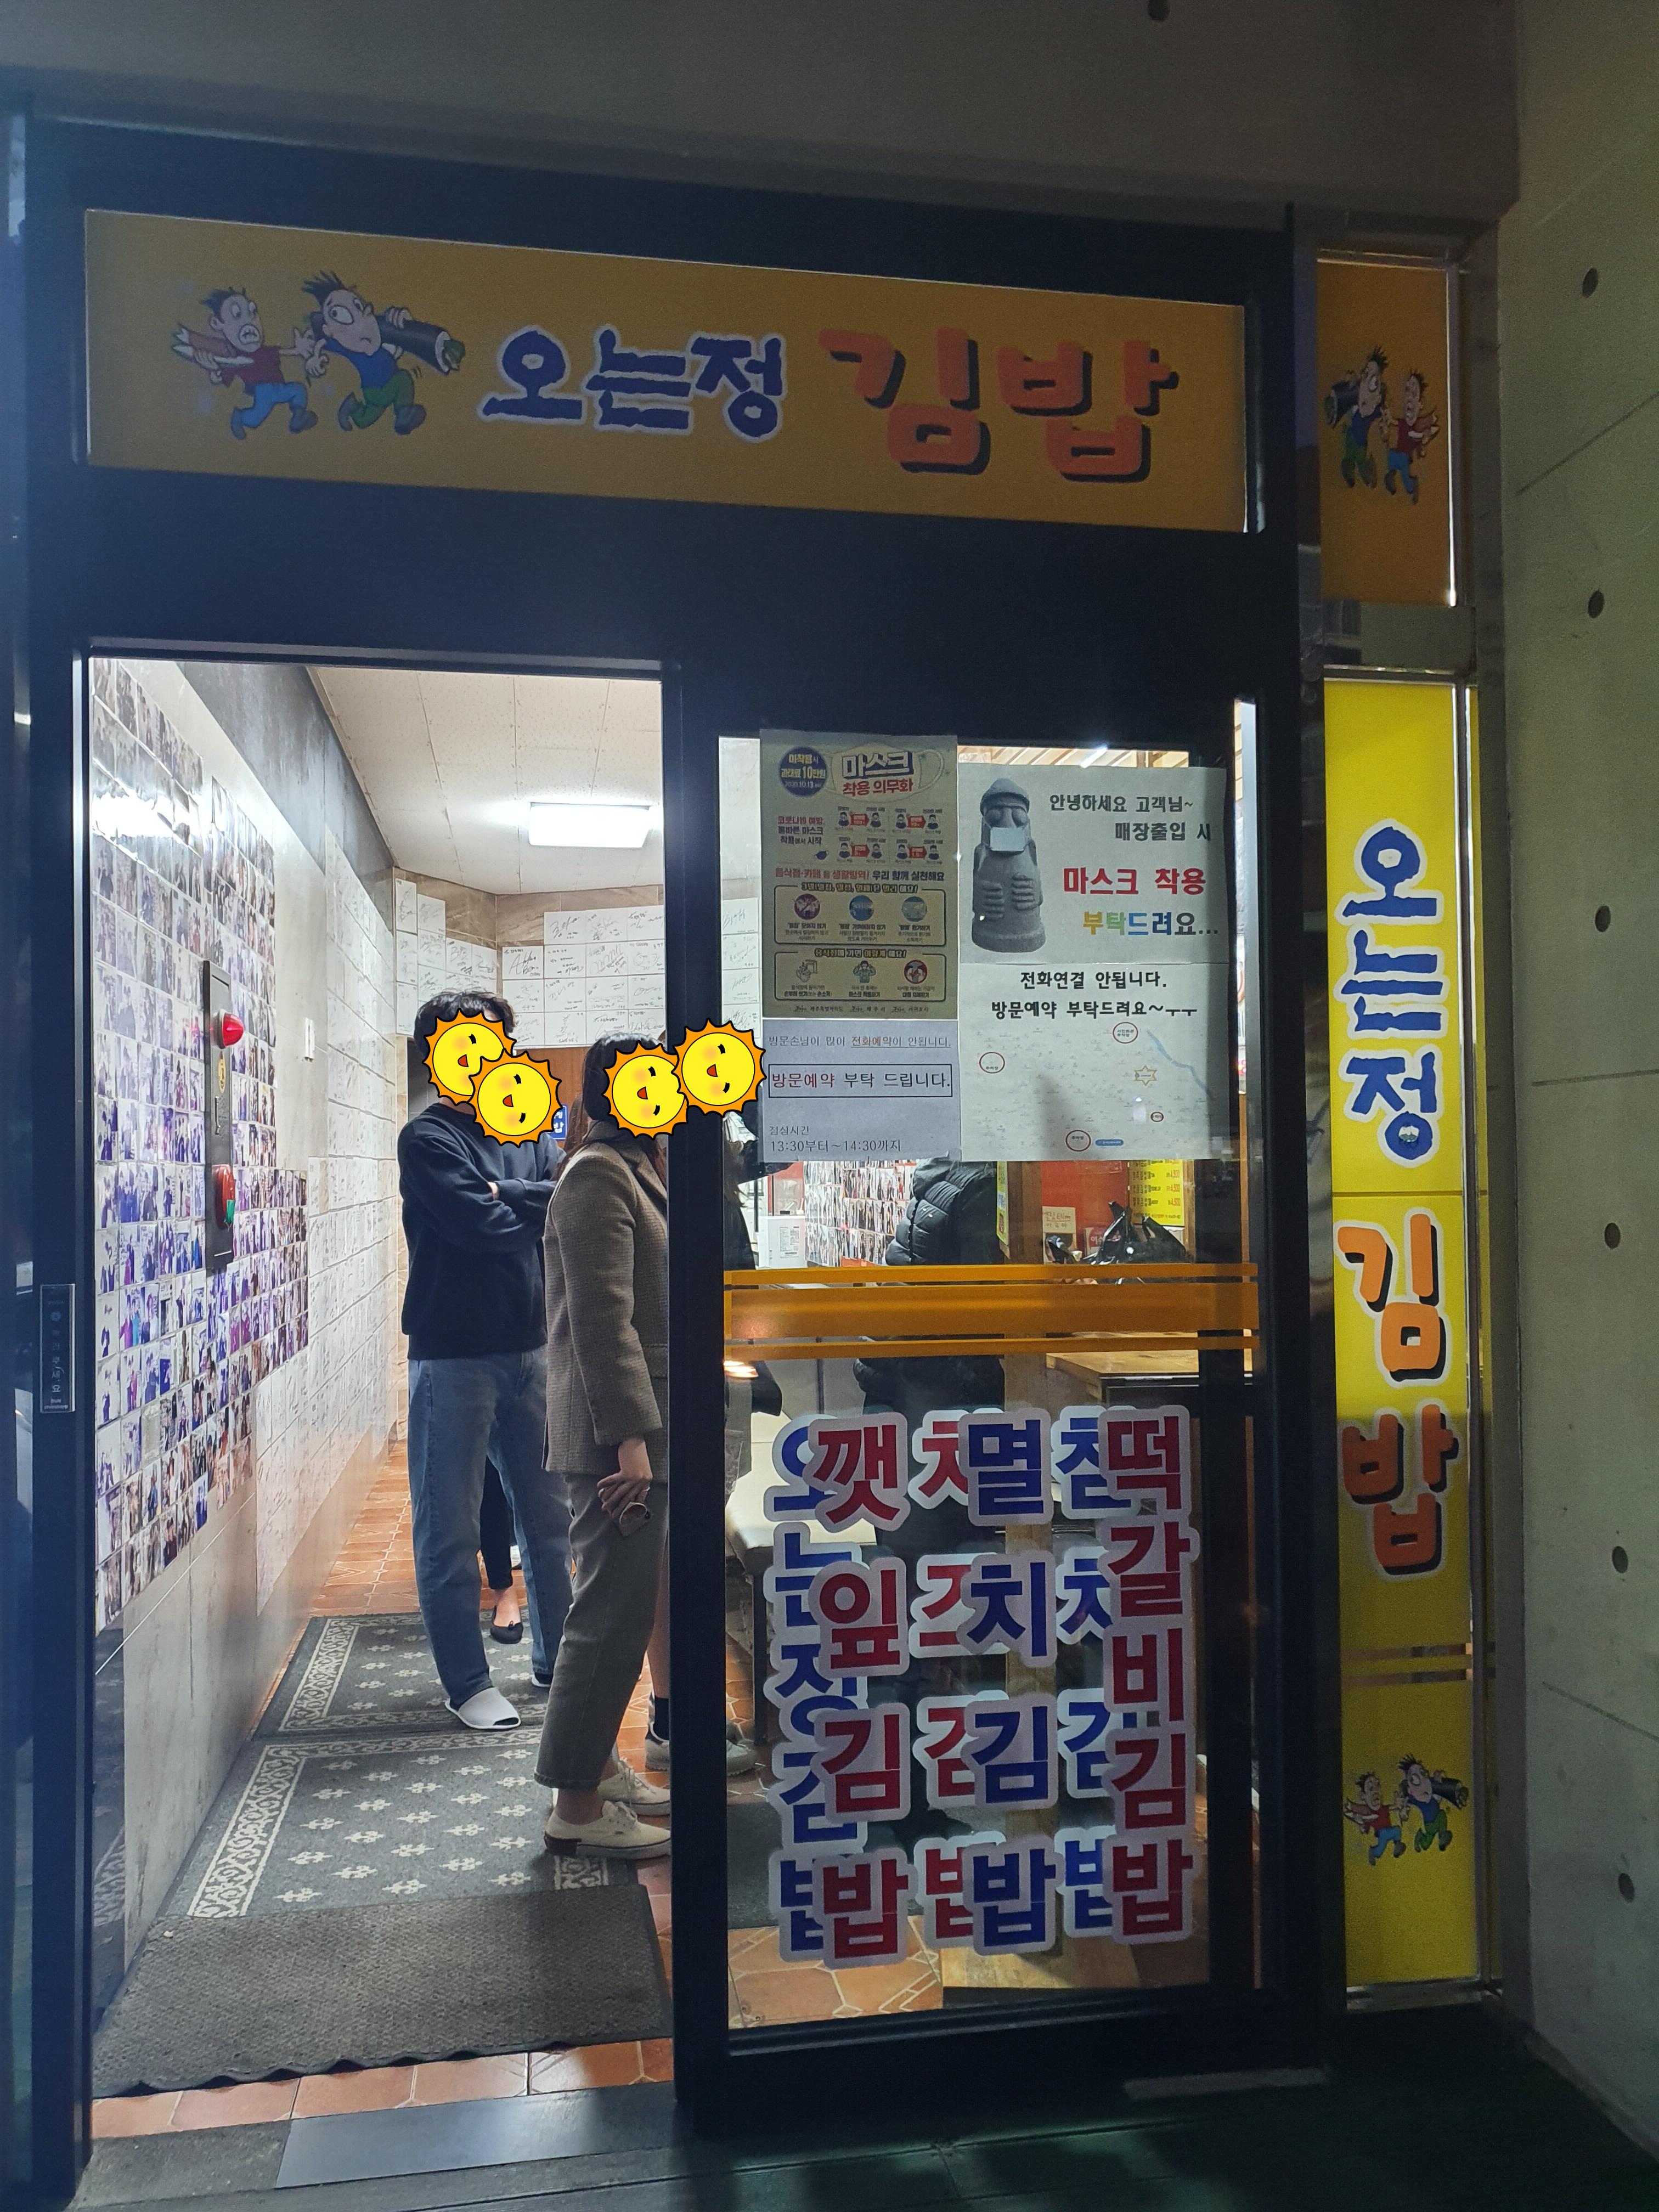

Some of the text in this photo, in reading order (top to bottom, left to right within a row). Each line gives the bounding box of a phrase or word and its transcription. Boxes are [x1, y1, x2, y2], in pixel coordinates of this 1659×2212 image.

[479, 326, 1180, 482] 오는정 김밥
[842, 749, 915, 779] 마스크
[843, 778, 913, 797] 착용 의무화
[1049, 794, 1127, 812] 안녕하세요
[802, 826, 823, 835] 마스크
[1115, 822, 1211, 841] 매장출입 시
[808, 836, 822, 846] 시작
[872, 871, 890, 881] 우리
[892, 871, 909, 881] 함께
[911, 871, 945, 882] 실천해요
[1063, 867, 1206, 895] 마스크 착용
[1020, 972, 1167, 990] 전화연결 안됩니다.
[1340, 826, 1443, 1163] 오는정
[991, 1001, 1057, 1020] 방문예약
[851, 1036, 901, 1047] 전화예약이
[772, 1073, 951, 1089] 방문예약 부탁 드립니다.
[769, 1125, 810, 1136] 점심시간
[1337, 1214, 1458, 1576] 김밥
[968, 1419, 1056, 1946] 멸치김밥
[1107, 1415, 1194, 1936] 떡갈비김밥
[813, 1424, 909, 1959] 깻잎김밥
